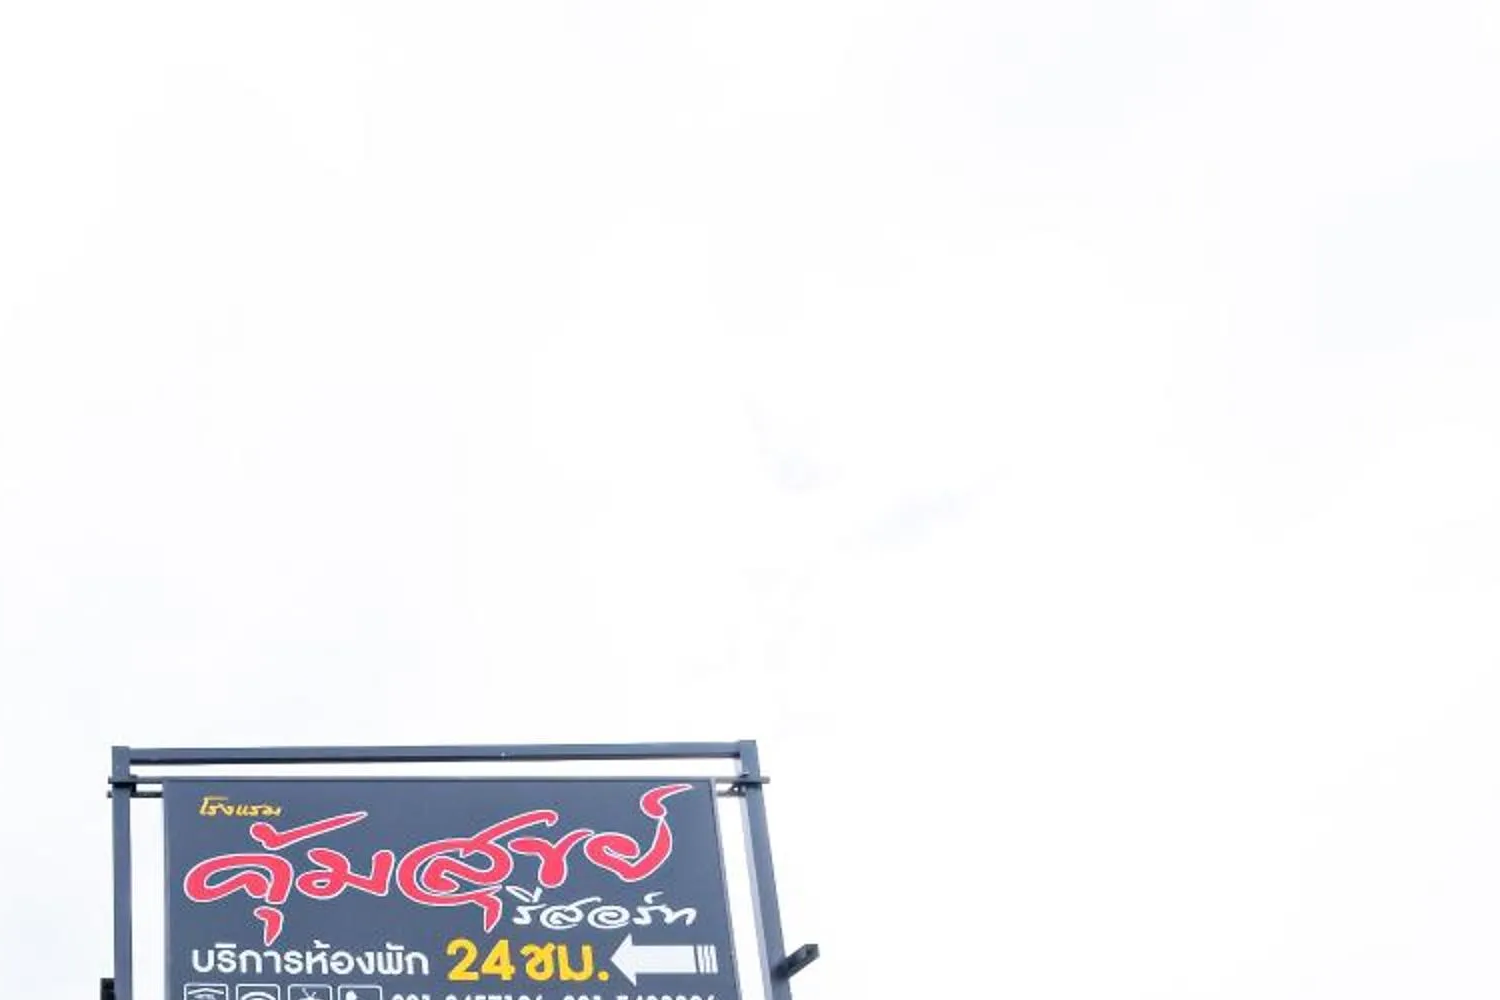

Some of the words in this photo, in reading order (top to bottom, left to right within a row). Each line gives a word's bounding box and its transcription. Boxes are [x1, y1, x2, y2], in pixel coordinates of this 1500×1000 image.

[199, 796, 282, 817] โรงแรม
[505, 885, 697, 929] รีสอร์ท
[192, 939, 430, 976] บริการห้องพัก
